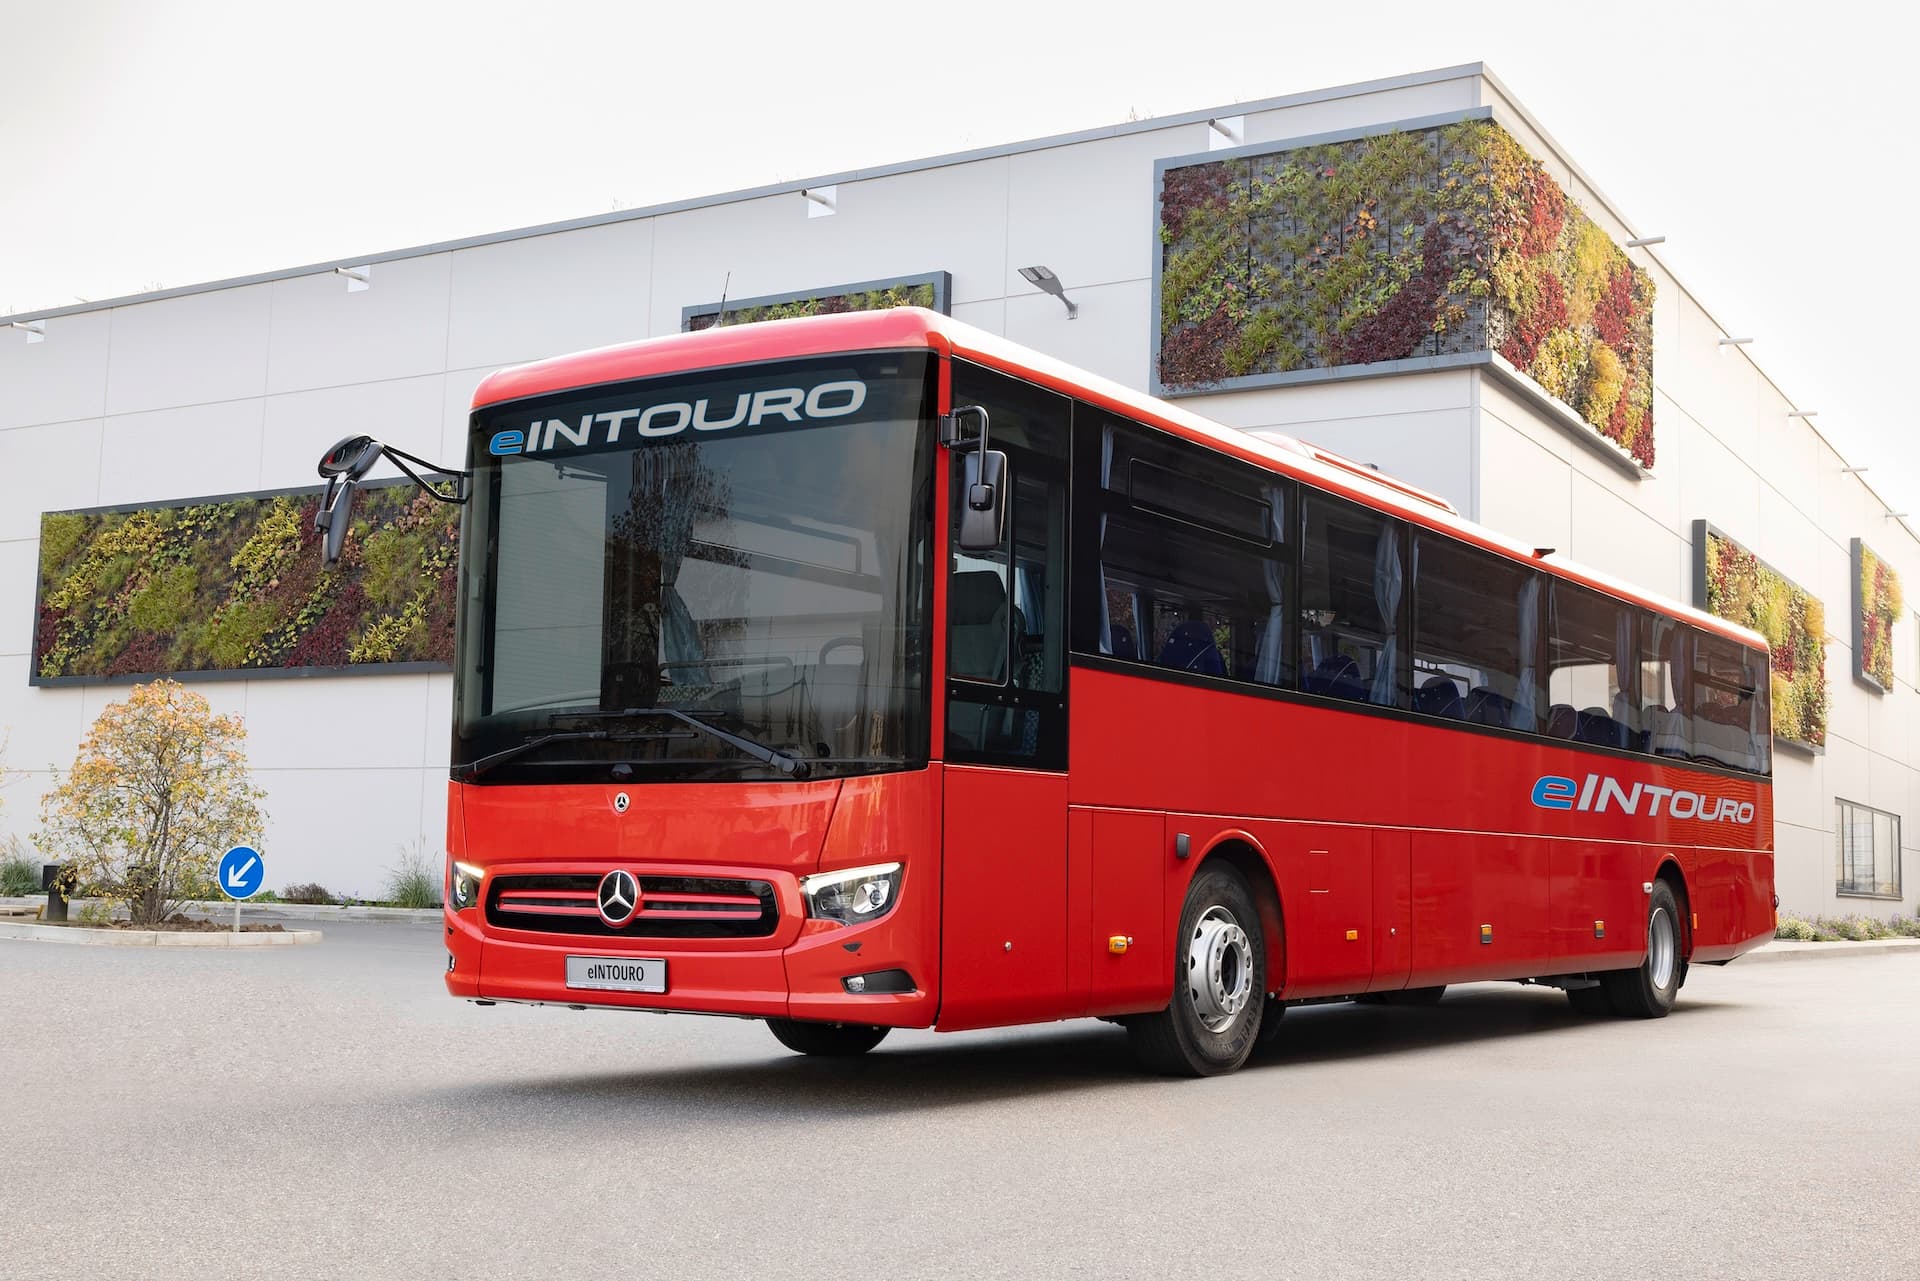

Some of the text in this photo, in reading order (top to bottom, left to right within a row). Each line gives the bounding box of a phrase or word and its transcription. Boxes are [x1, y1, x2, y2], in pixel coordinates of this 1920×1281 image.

[489, 381, 867, 455] eINTOURO
[1532, 773, 1755, 823] eINTOURO
[587, 964, 645, 982] eINTOURO
